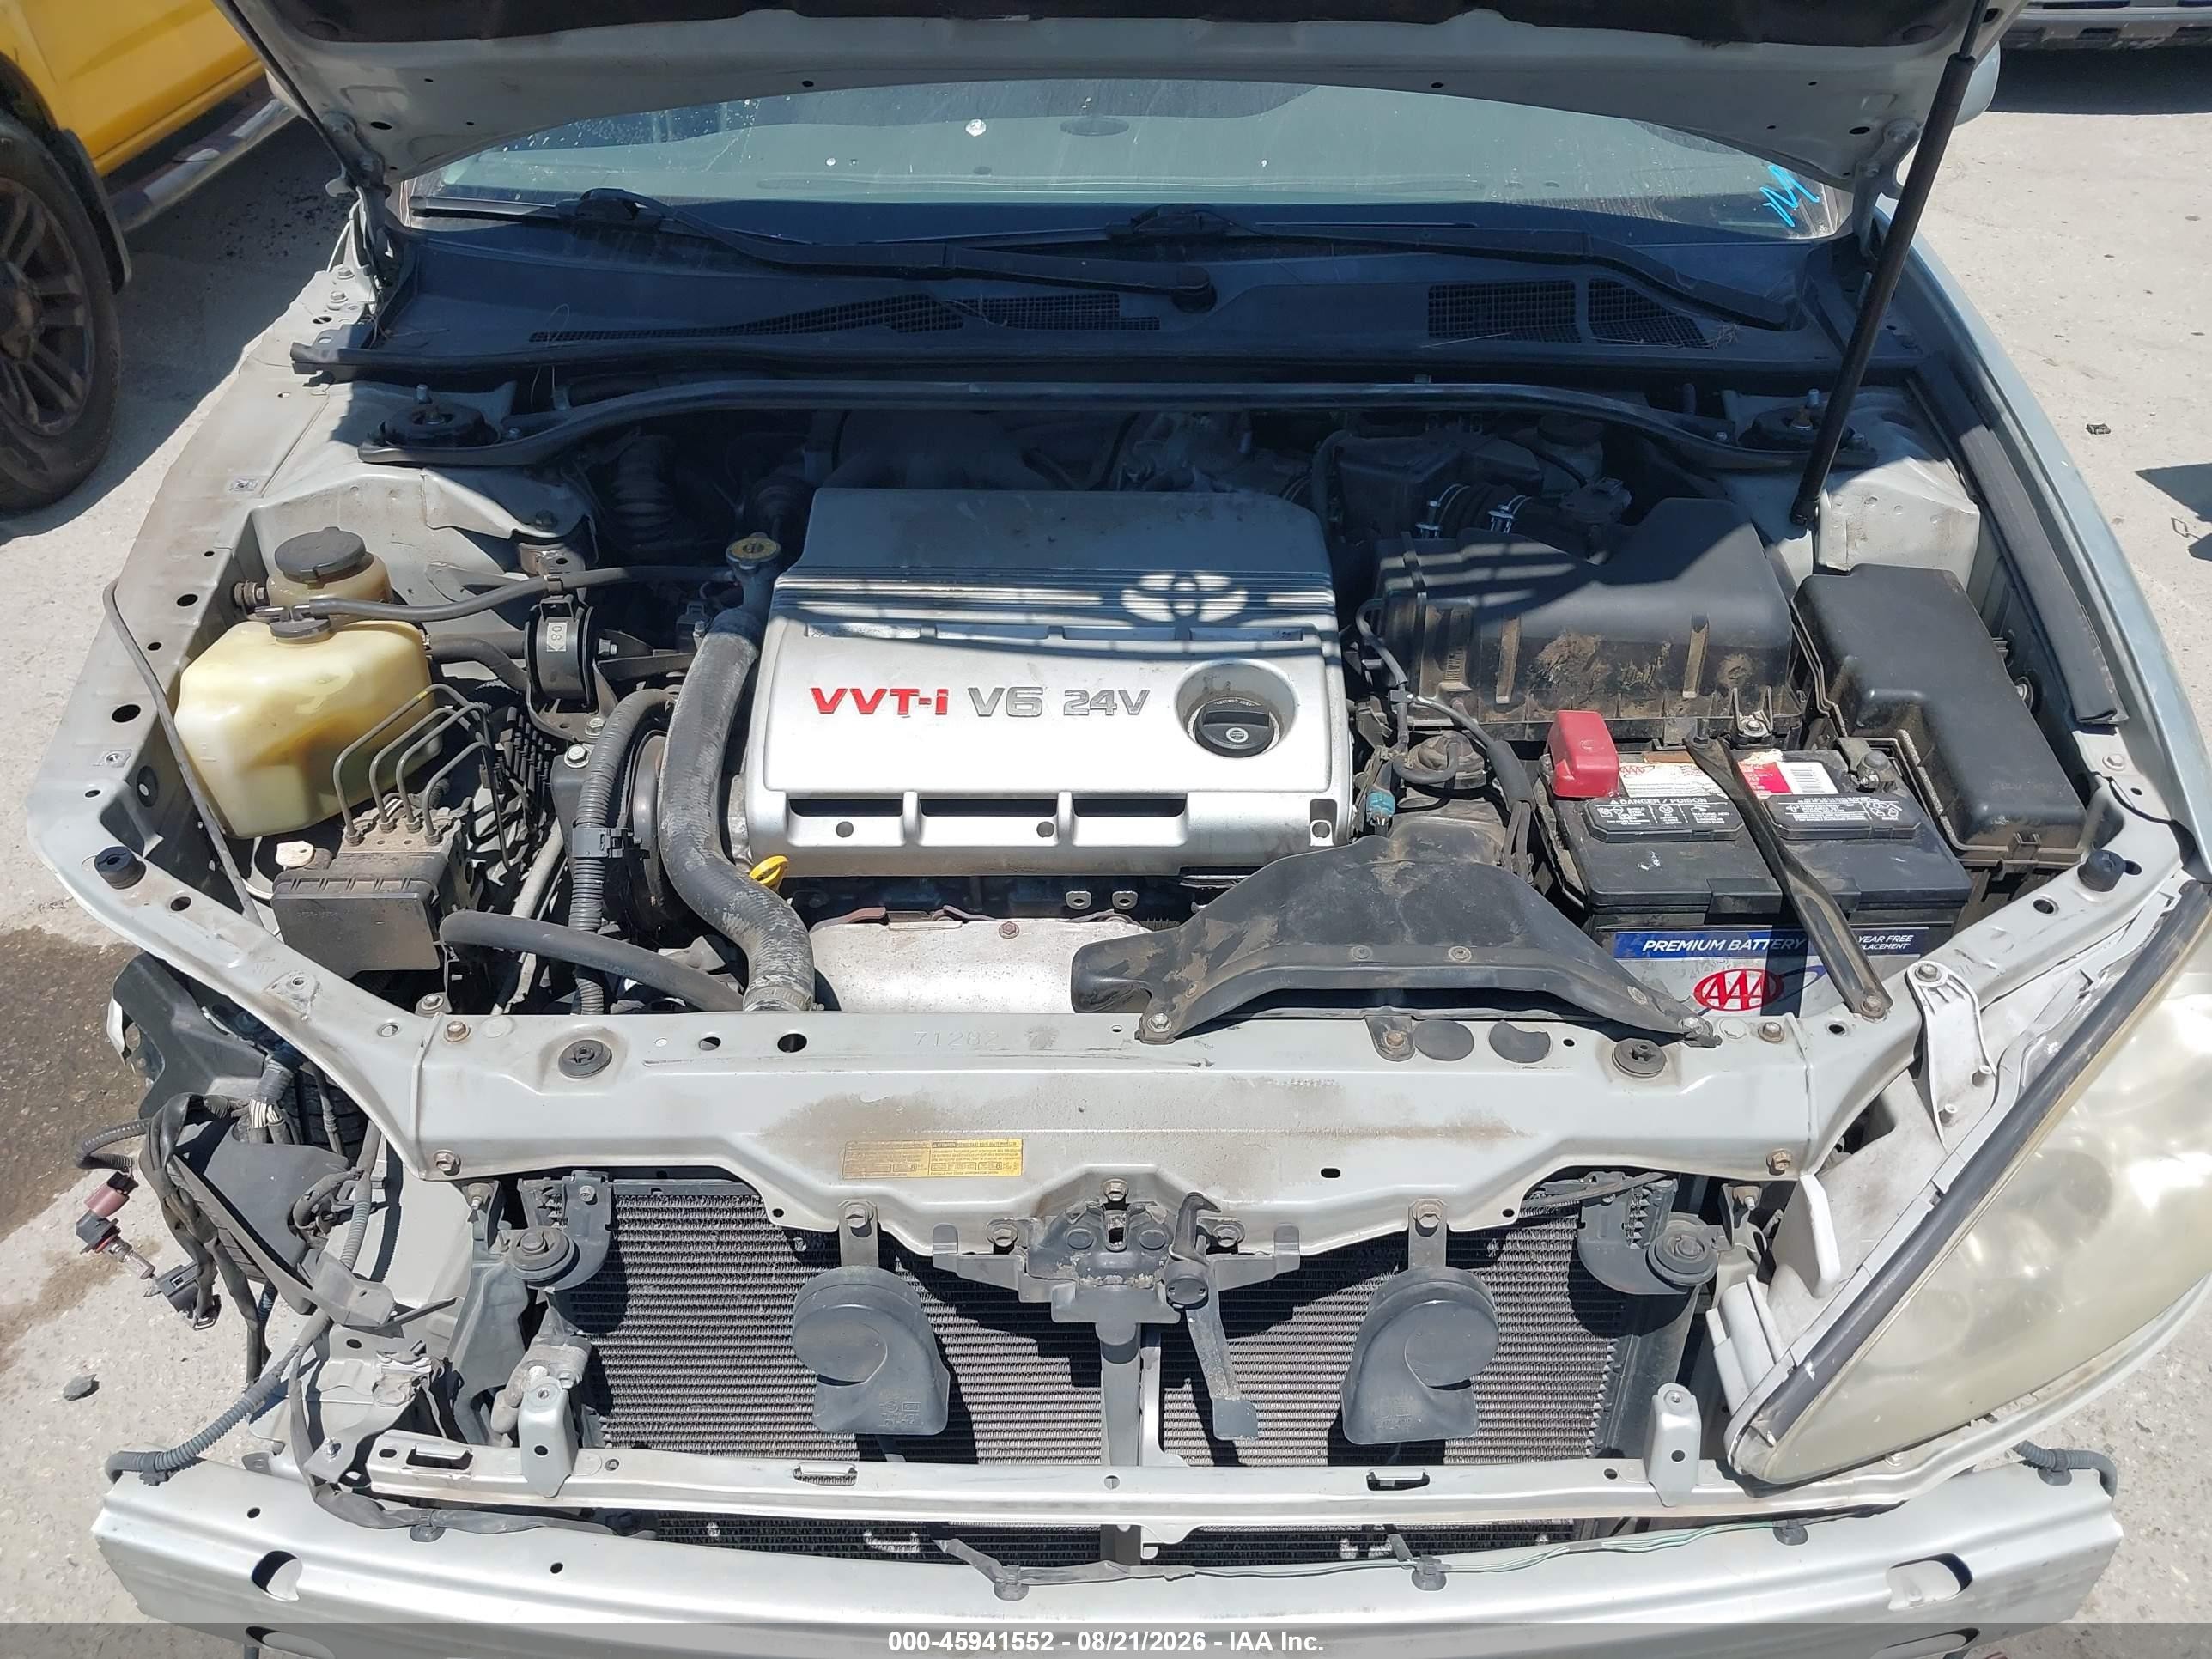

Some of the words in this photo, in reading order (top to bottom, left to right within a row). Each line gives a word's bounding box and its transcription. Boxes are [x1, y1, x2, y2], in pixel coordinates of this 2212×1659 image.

[810, 687, 949, 715] VVT-i
[968, 687, 1044, 717] V6
[1063, 688, 1151, 716] 24V
[1642, 939, 1723, 951] PREMIUM
[1727, 939, 1805, 951] BATTERY
[1697, 969, 1781, 1011] AAA
